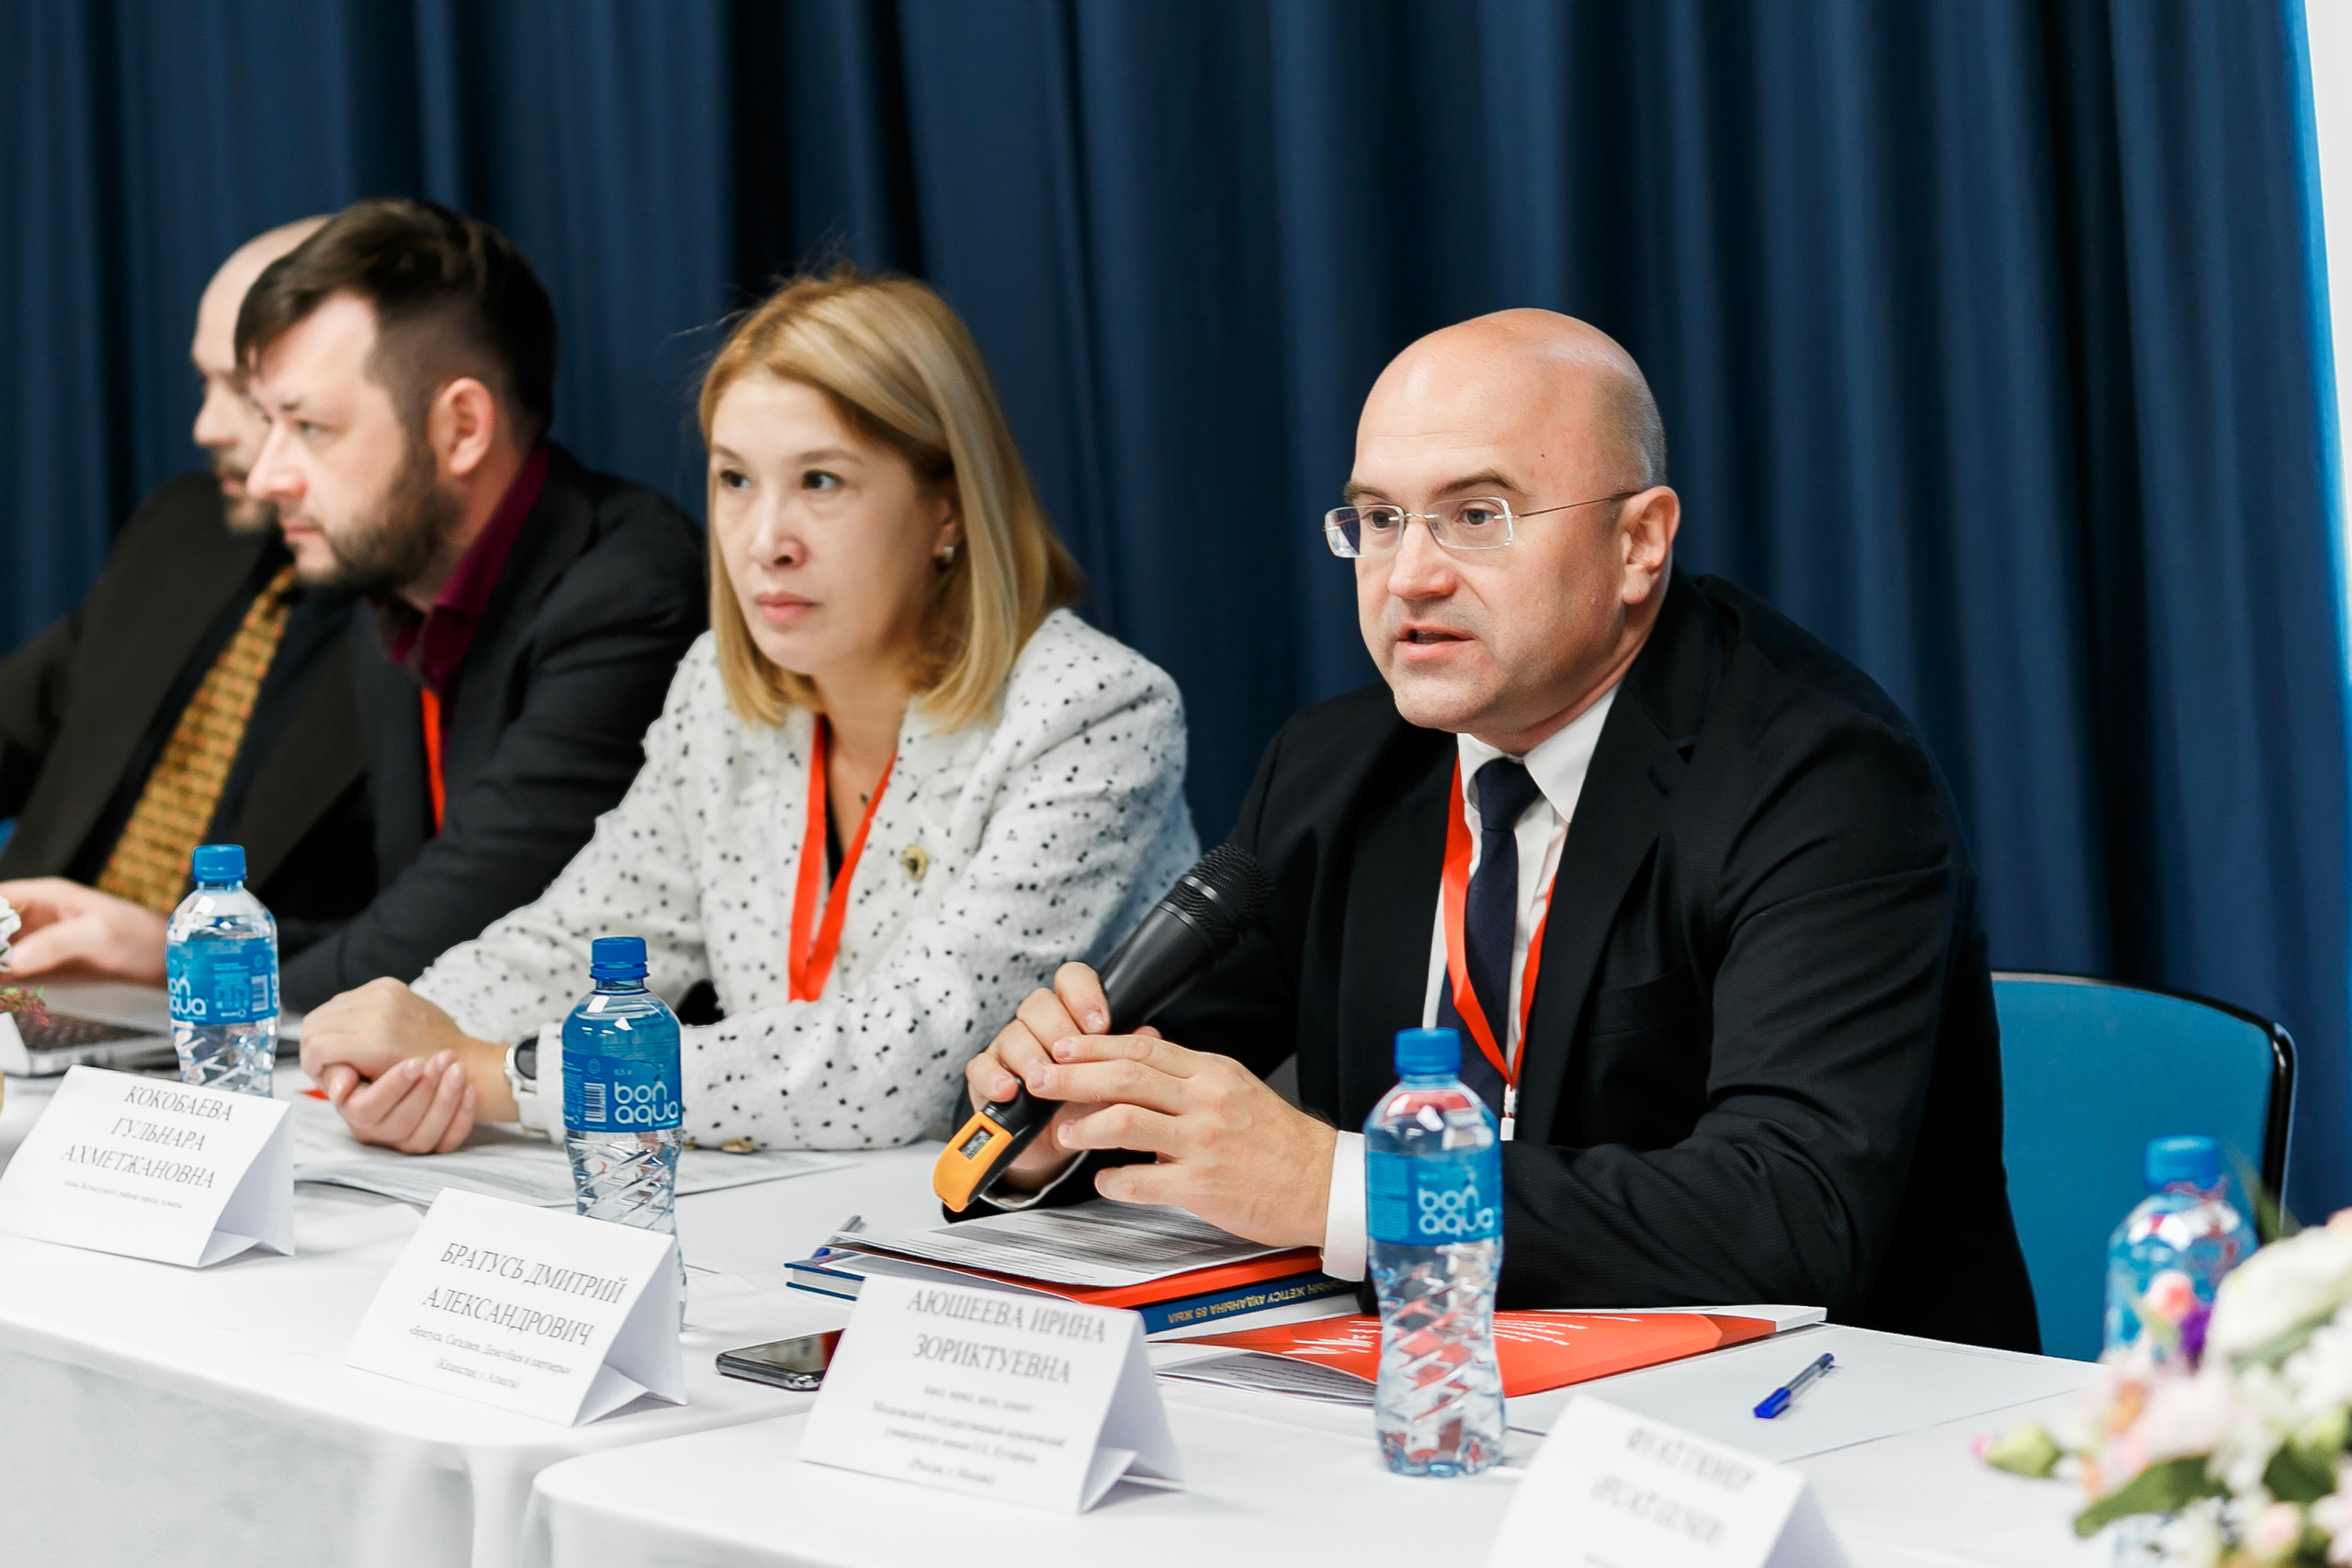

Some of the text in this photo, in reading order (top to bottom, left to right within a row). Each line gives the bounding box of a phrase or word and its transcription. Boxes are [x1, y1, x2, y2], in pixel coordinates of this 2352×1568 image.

[124, 1086, 233, 1121] КОКОБАЕВА
[614, 1081, 667, 1104] bon
[615, 1100, 678, 1127] aqua
[111, 1117, 206, 1151] ГУЛЬНАРА
[61, 1145, 215, 1189] АХМЕТЖАНОВНА
[1418, 1184, 1479, 1213] bon
[1419, 1208, 1494, 1236] aqua
[440, 1242, 628, 1303] БРАТУСЬ ДМИТРИЙ
[422, 1287, 594, 1346] АЛЕКСАНДРОВИЧ
[906, 1289, 1106, 1342] АЮШЕЕВА ИРИНА
[1195, 1306, 1207, 1318] 85
[912, 1333, 1070, 1384] ЗОРИКТУЕВНА
